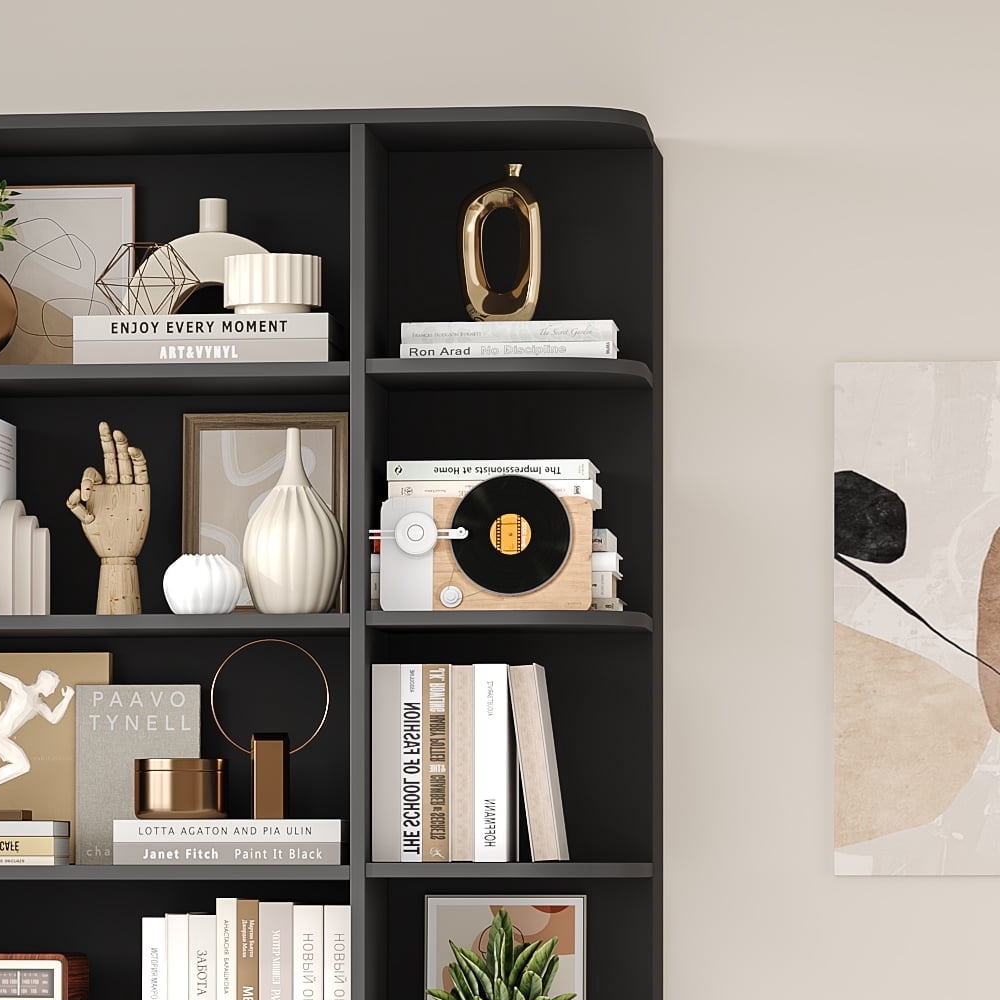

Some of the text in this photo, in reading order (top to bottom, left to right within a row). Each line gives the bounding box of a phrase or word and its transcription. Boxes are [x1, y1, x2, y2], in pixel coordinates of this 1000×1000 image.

[111, 320, 288, 334] ENJOY EVERY MOMENT
[160, 345, 238, 359] ART&VYNYL
[409, 346, 471, 357] Ron Arad
[480, 344, 567, 355] No Discipline
[433, 466, 460, 475] Home
[475, 465, 542, 475] Impressionists
[545, 466, 561, 475] The
[88, 691, 191, 731] PAAVO TYNELL
[138, 826, 312, 836] LOTTA AGATON AND PIA ULIN
[143, 848, 219, 860] Janet Fitch
[234, 848, 323, 860] Paint It Black
[302, 933, 316, 984] НОВЫЙ
[334, 933, 347, 984] НОВЫЙ
[196, 949, 207, 996] ЗАБОТА
